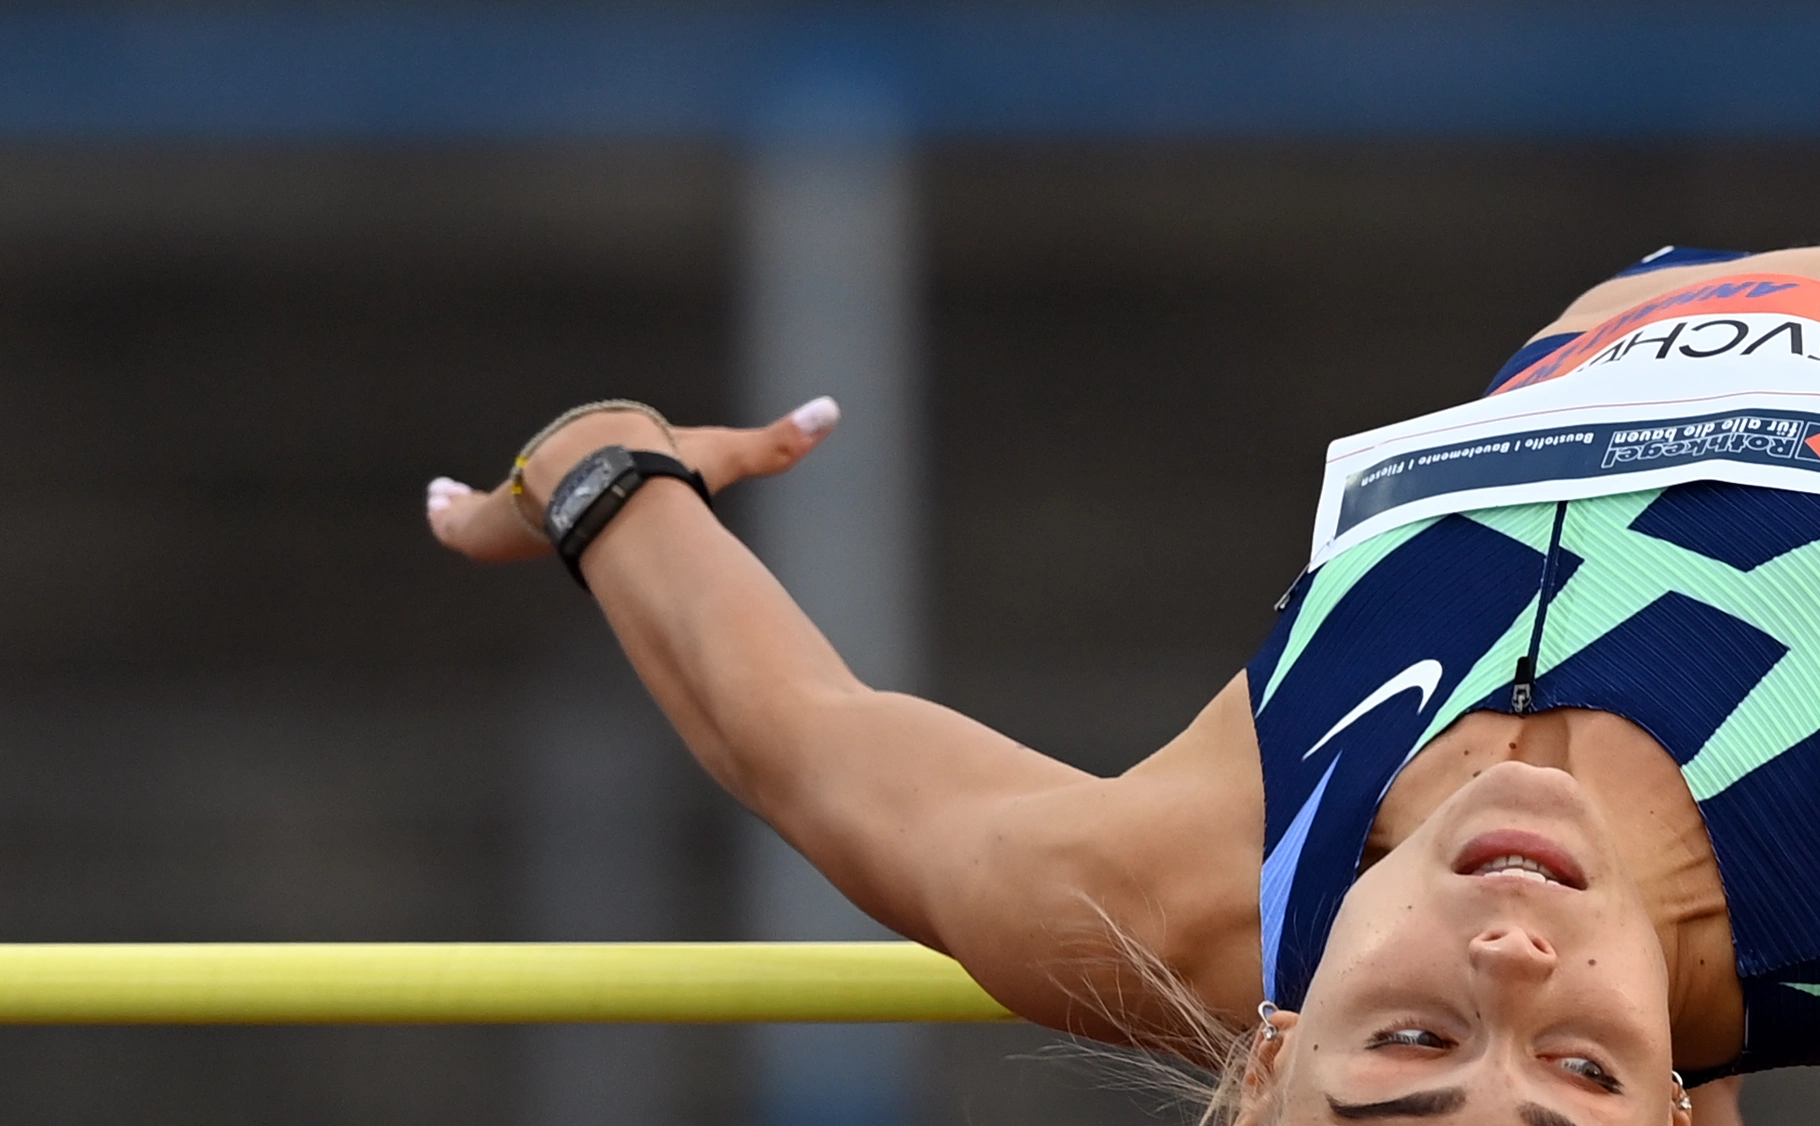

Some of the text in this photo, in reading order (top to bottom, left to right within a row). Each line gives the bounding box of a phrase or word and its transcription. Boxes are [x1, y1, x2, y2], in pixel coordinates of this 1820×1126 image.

[1615, 418, 1798, 443] für alle die bauen
[1361, 432, 1594, 487] Baustoffe Bauelemente Fliesen
[1601, 433, 1796, 468] Rothkegel
